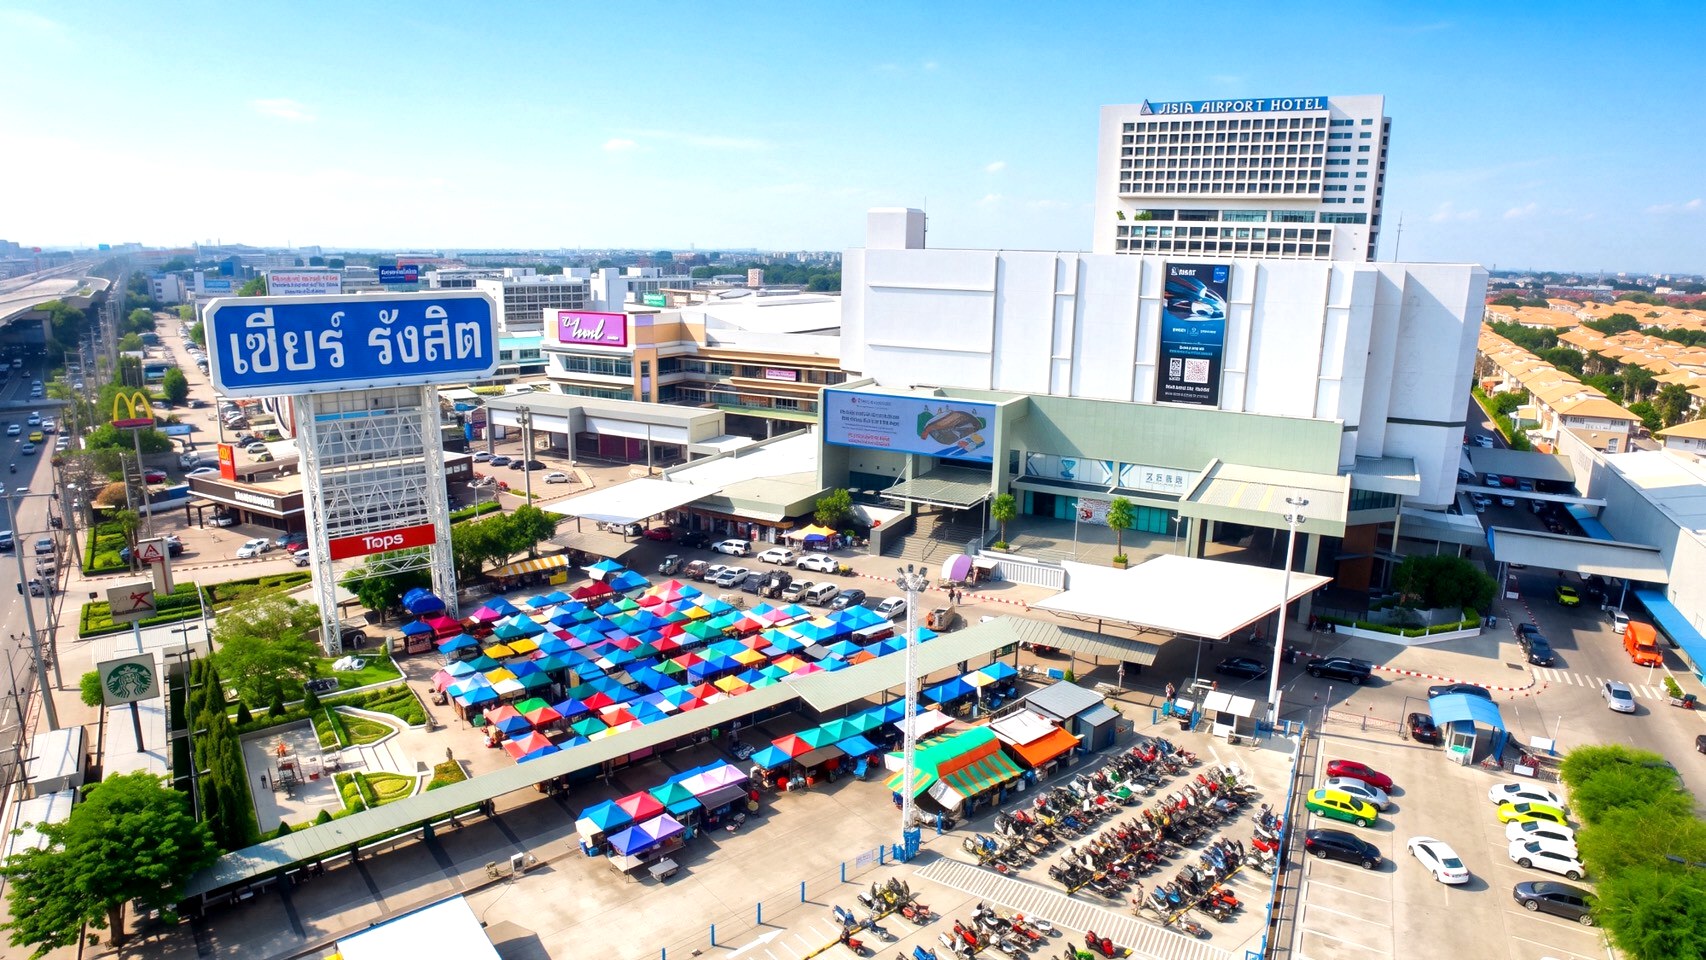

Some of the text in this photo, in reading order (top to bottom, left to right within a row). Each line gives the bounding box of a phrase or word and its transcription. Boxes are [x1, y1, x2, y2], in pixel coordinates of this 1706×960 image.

[1158, 98, 1323, 115] JISIA AIRPORT HOTEL
[230, 305, 483, 375] เซียร์ รังสิต
[362, 533, 404, 550] Tops
